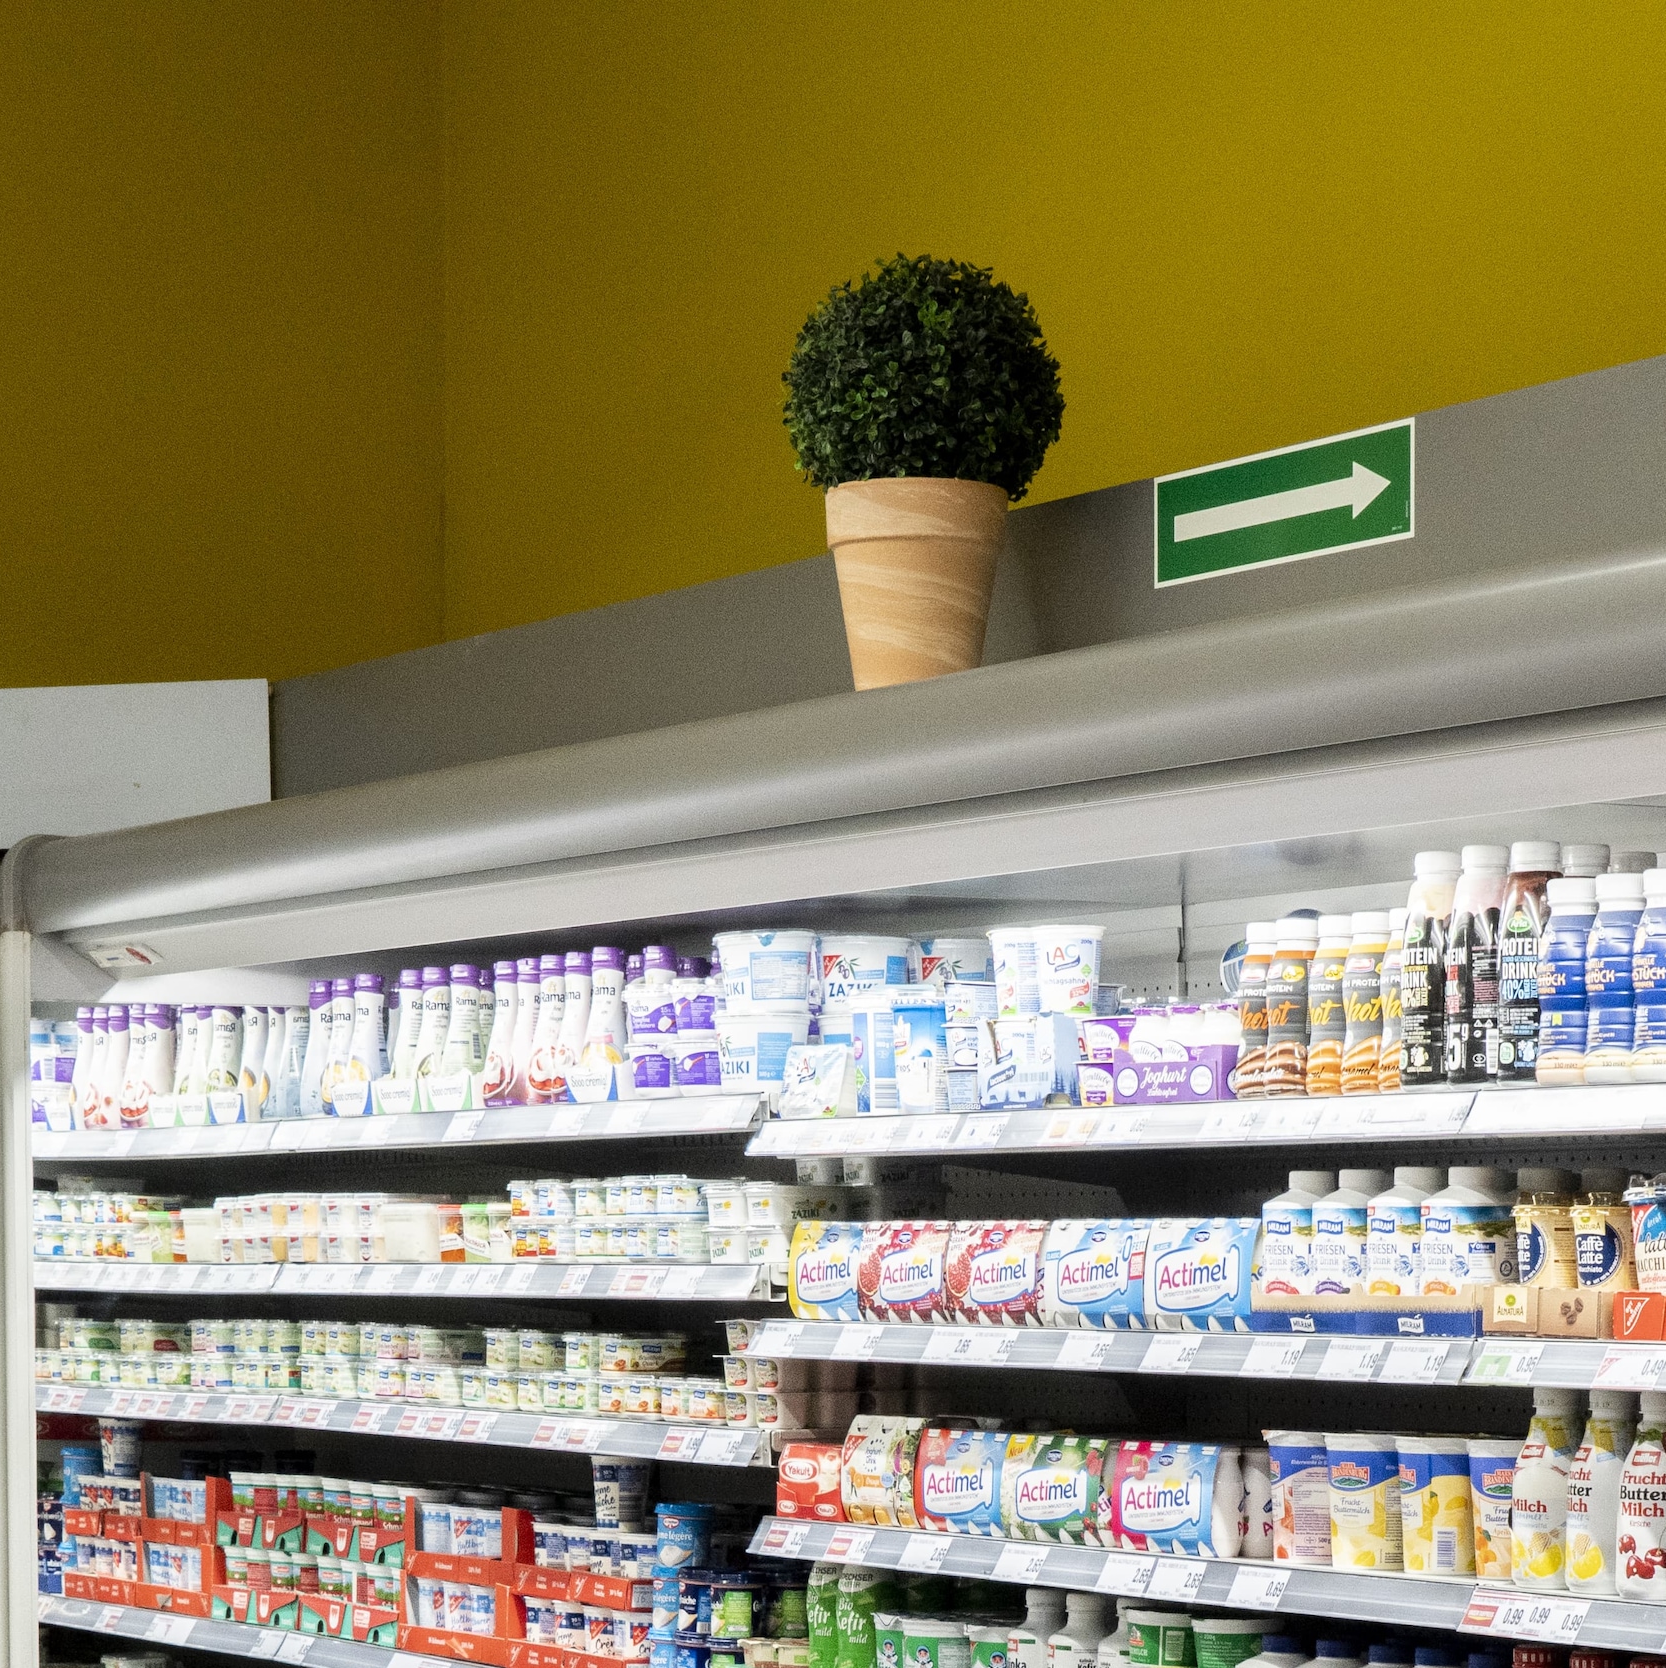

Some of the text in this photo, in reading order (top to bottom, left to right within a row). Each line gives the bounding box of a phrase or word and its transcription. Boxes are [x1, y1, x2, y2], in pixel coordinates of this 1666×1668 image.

[1317, 1221, 1342, 1234] MILRAM
[1315, 1244, 1346, 1255] FRIESEN
[799, 1259, 851, 1284] Actimel
[1060, 1261, 1119, 1283] Actimel
[1158, 1261, 1227, 1285] Actimel
[1359, 1354, 1379, 1369] 1.19
[788, 1465, 811, 1478] Yakult
[1622, 1471, 1666, 1485] Frucht
[1019, 1478, 1078, 1502] Actimel
[1124, 1486, 1190, 1511] Actimel
[1621, 1502, 1665, 1517] Milch
[1133, 1568, 1151, 1584] 2.65
[1503, 1608, 1524, 1625] 0.99
